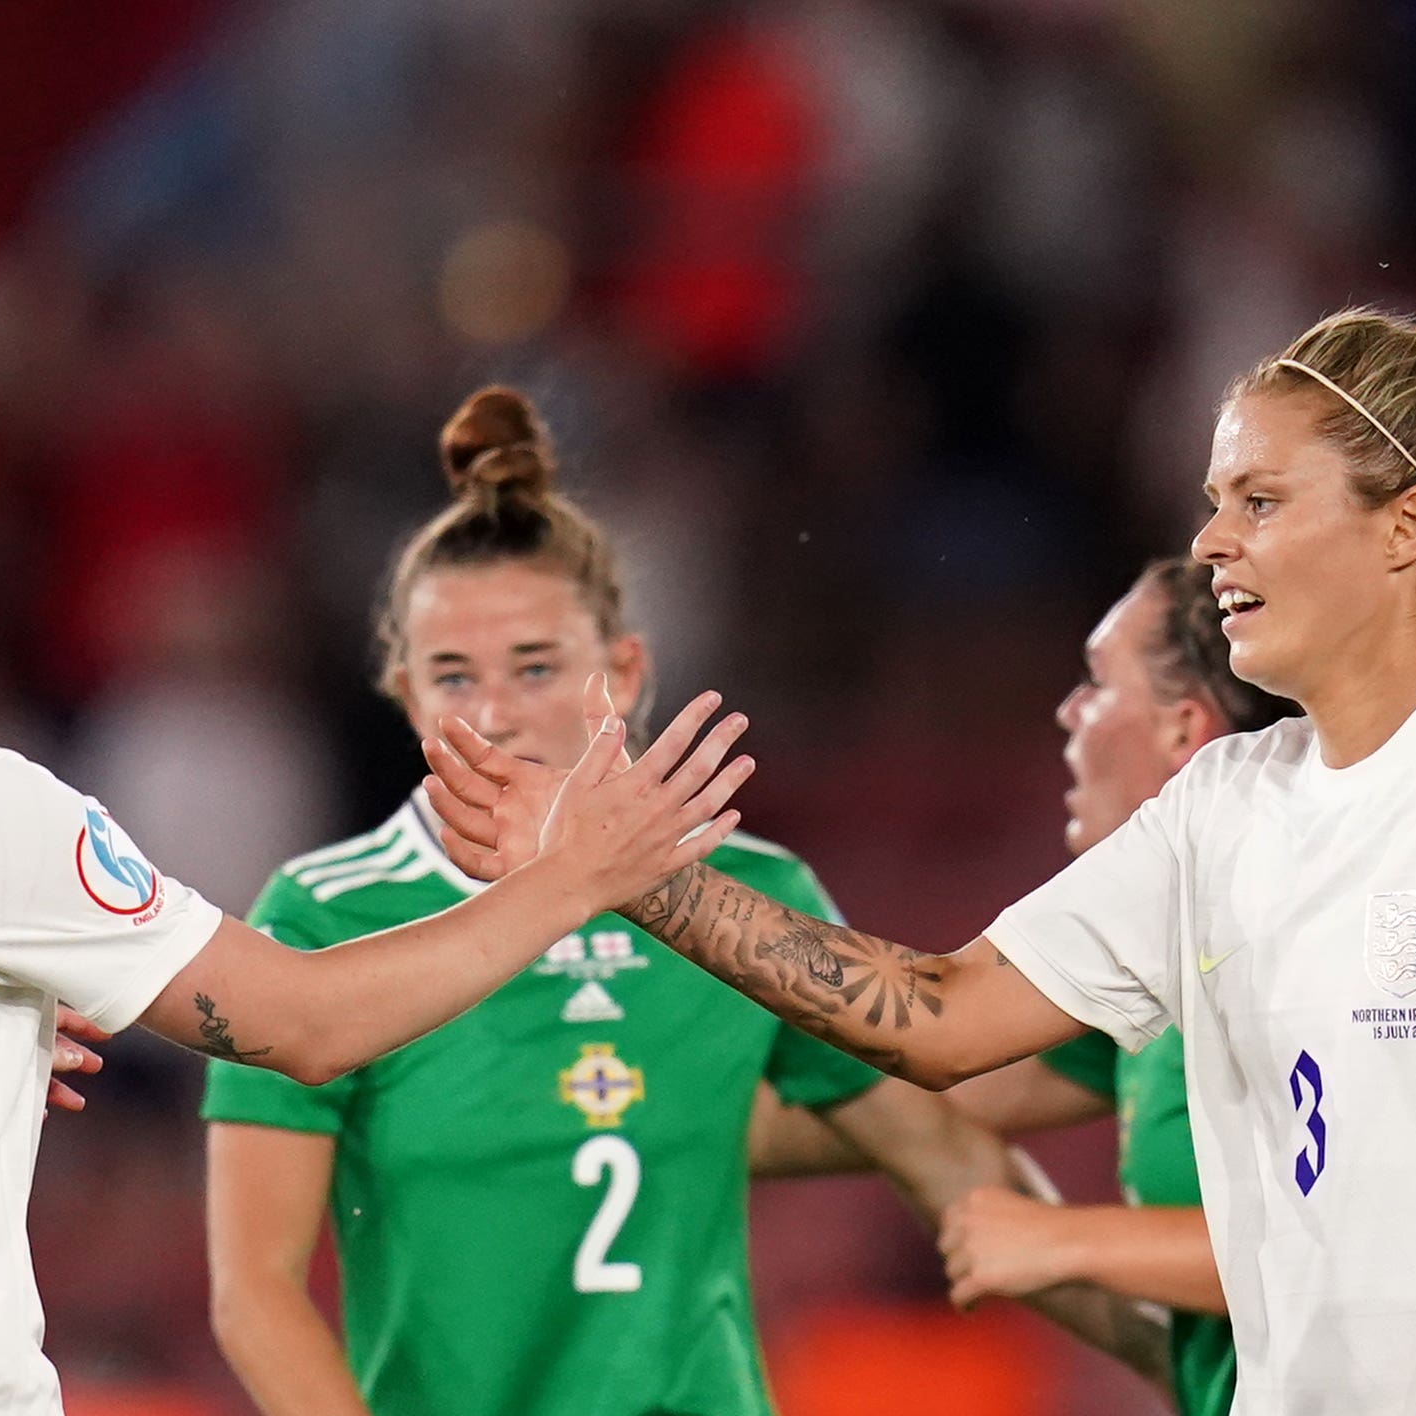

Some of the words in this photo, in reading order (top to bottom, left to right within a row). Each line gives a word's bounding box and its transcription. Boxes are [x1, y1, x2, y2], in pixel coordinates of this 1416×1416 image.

[1352, 1008, 1406, 1023] NORTHERN
[1373, 1026, 1383, 1040] 15
[1384, 1025, 1411, 1040] JULY
[1289, 1050, 1327, 1198] 3
[571, 1134, 643, 1293] 2
